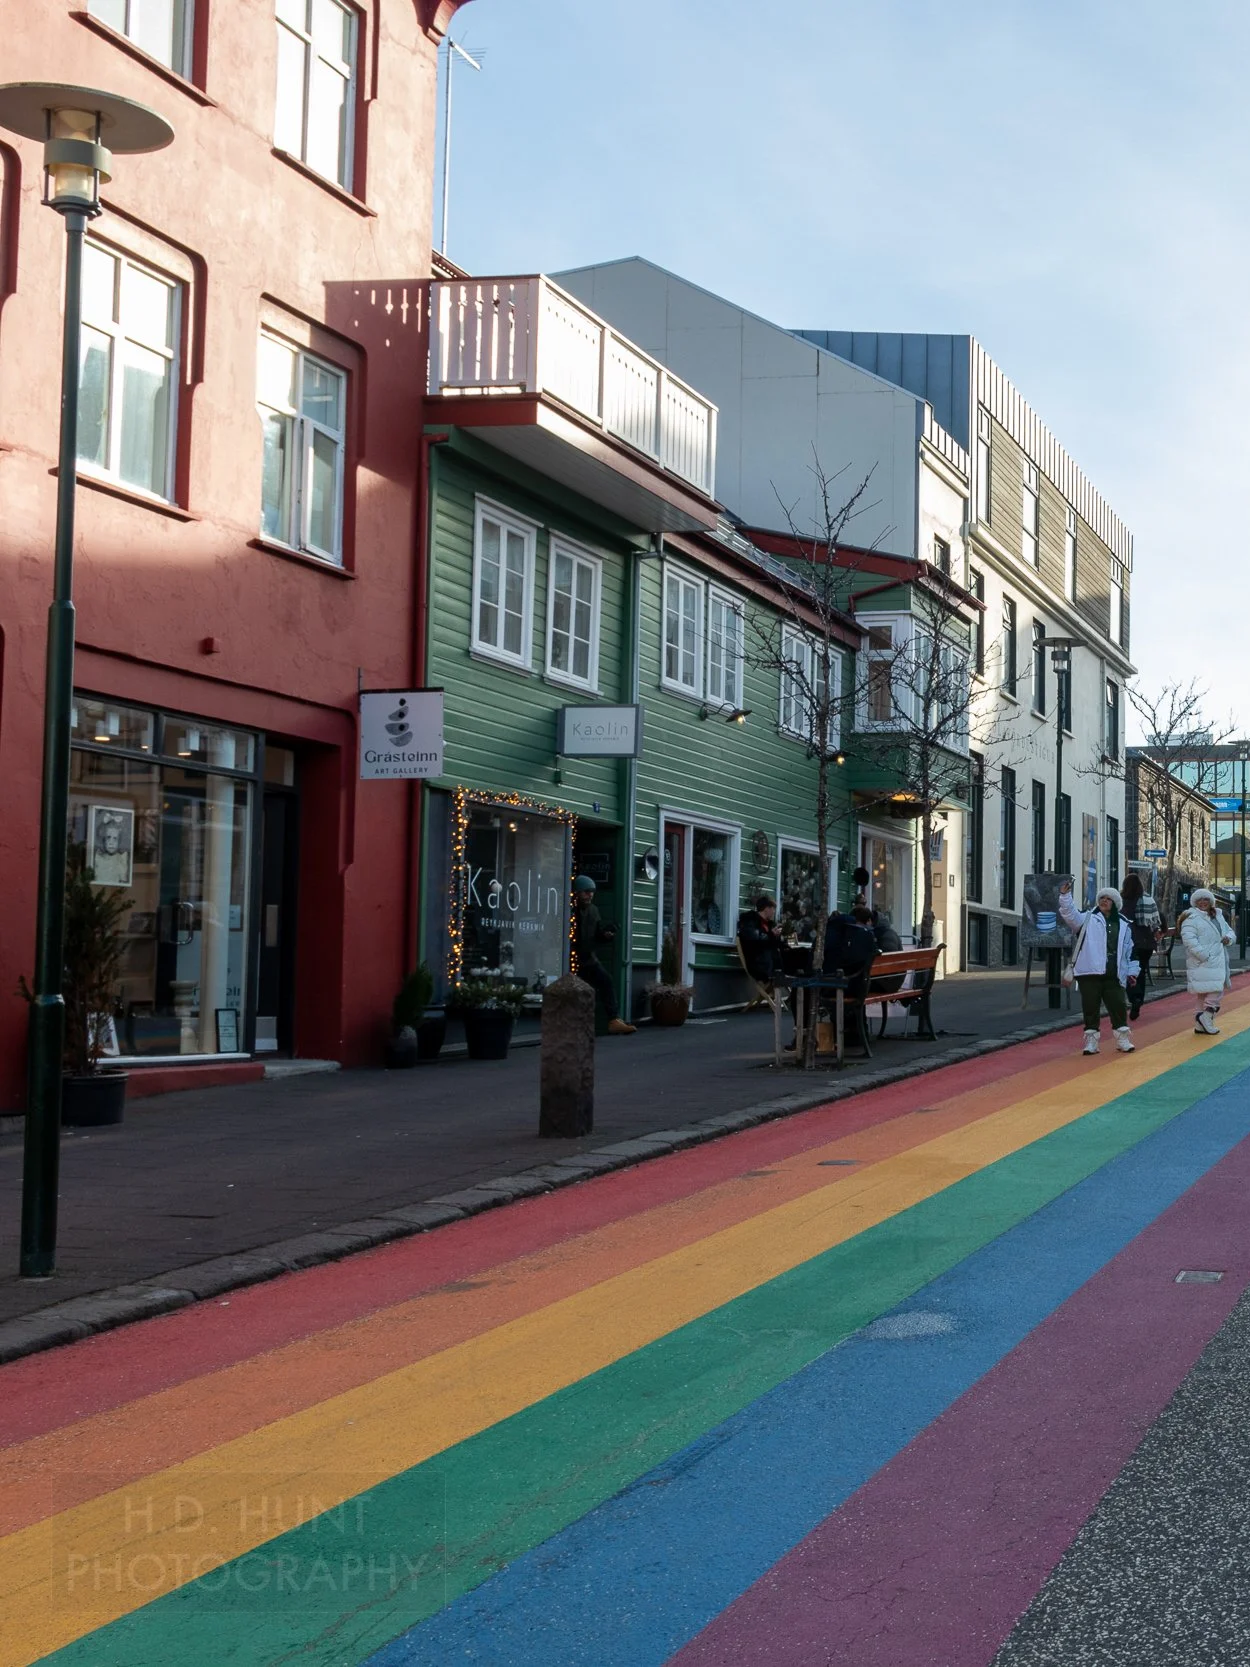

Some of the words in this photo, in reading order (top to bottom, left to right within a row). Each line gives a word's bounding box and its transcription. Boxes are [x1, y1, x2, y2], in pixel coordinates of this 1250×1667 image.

[572, 722, 628, 736] Kaolin
[364, 750, 438, 763] Grásteinn
[393, 766, 429, 775] GALLERY
[467, 866, 558, 916] Kaolin
